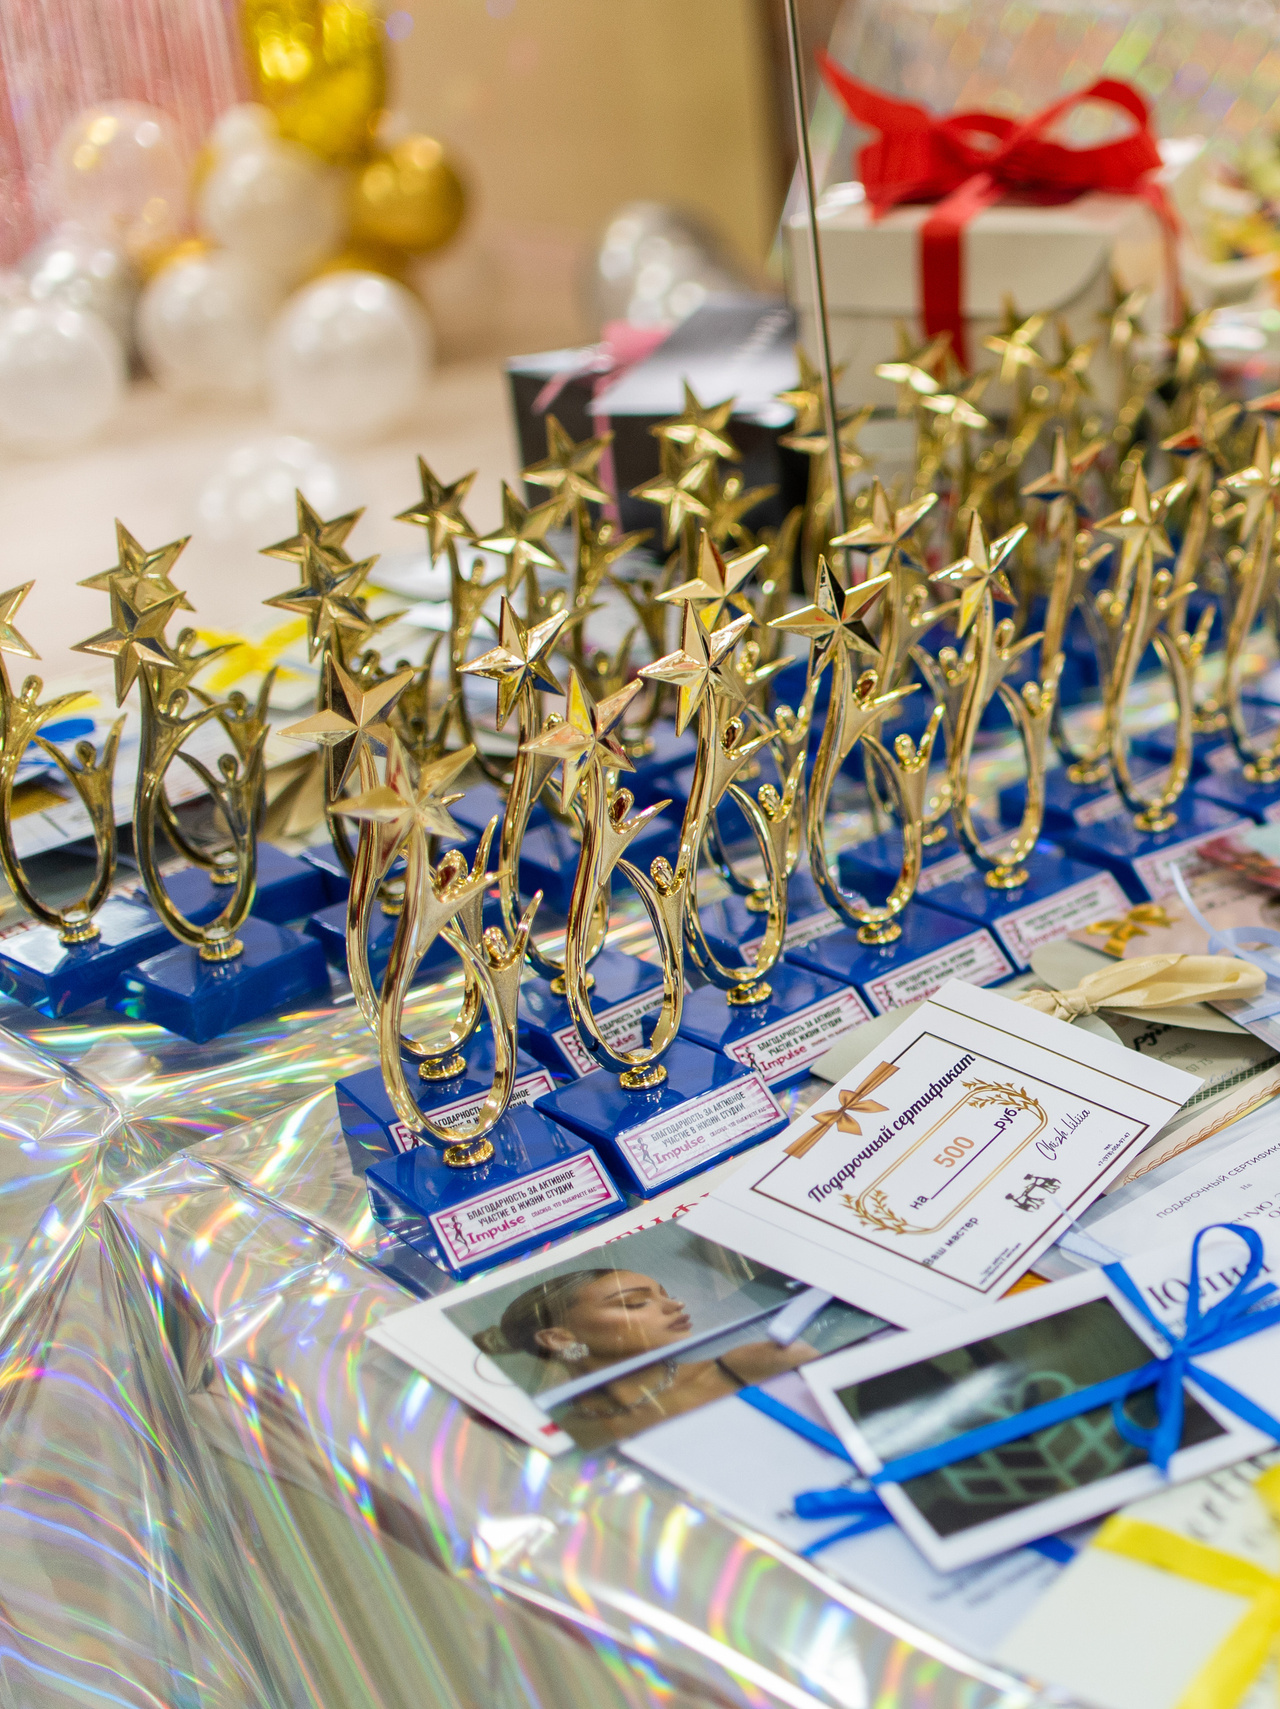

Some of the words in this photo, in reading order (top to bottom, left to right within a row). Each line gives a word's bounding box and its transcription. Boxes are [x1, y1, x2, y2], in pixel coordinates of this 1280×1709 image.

[759, 1045, 808, 1072] Impulse
[650, 1112, 704, 1142] БЛАГОДАРНОСТЬ
[703, 1107, 713, 1117] ЗА
[712, 1091, 746, 1112] АКТИВНОЕ
[662, 1130, 692, 1148] УЧАСТИЕ
[696, 1115, 721, 1132] ЖИЗНИ
[720, 1102, 746, 1120] СТУДИИ
[807, 1124, 896, 1203] Подарочный
[892, 1053, 976, 1132] сертификат
[652, 1134, 706, 1165] Impulse
[933, 1136, 975, 1168] 500
[466, 1191, 527, 1221] БЛАГОДАРНОСТЬ
[527, 1186, 539, 1196] ЗА
[538, 1169, 576, 1191] АКТИВНОЕ
[478, 1209, 511, 1227] УЧАСТИЕ
[518, 1195, 546, 1211] ЖИЗНИ
[546, 1182, 575, 1199] СТУДИИ
[1156, 1174, 1230, 1219] ПОДАРОЧНЫЙ
[466, 1214, 527, 1245] Impulse
[944, 1217, 979, 1247] мастер
